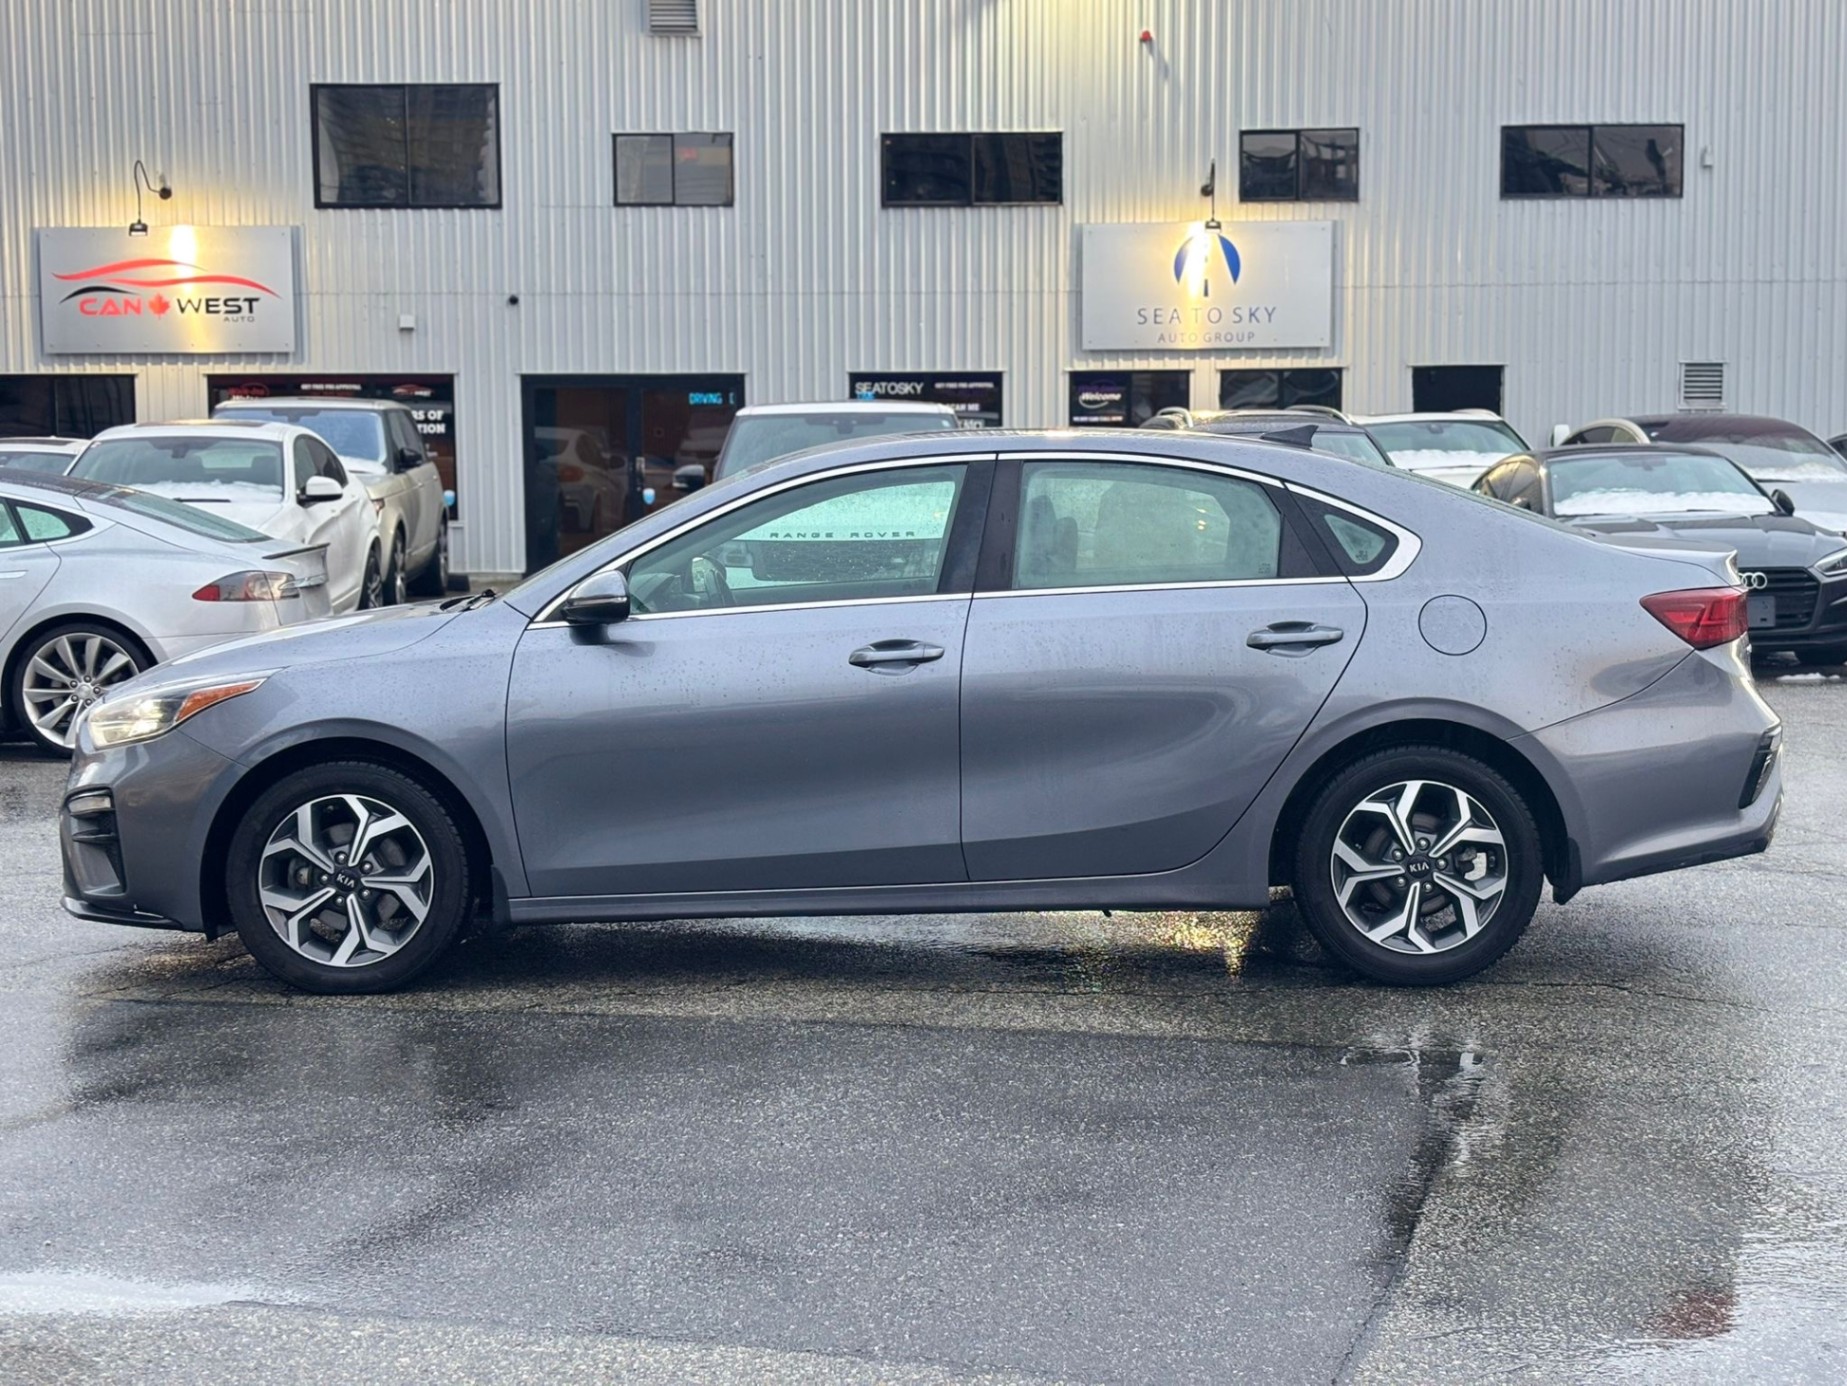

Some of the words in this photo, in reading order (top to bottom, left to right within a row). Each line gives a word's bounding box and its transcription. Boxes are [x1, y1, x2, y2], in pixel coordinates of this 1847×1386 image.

[79, 297, 142, 316] CAN
[176, 298, 261, 315] WEST
[1137, 308, 1182, 325] SEA
[1191, 307, 1222, 325] TO
[1232, 306, 1276, 324] SKY
[1157, 332, 1198, 344] AUTO
[1203, 331, 1255, 343] GROUP
[855, 382, 924, 395] SEATOSKY
[1081, 392, 1122, 401] Welcome
[427, 409, 444, 421] OF
[1409, 861, 1430, 873] KIA
[336, 873, 356, 888] KIA
